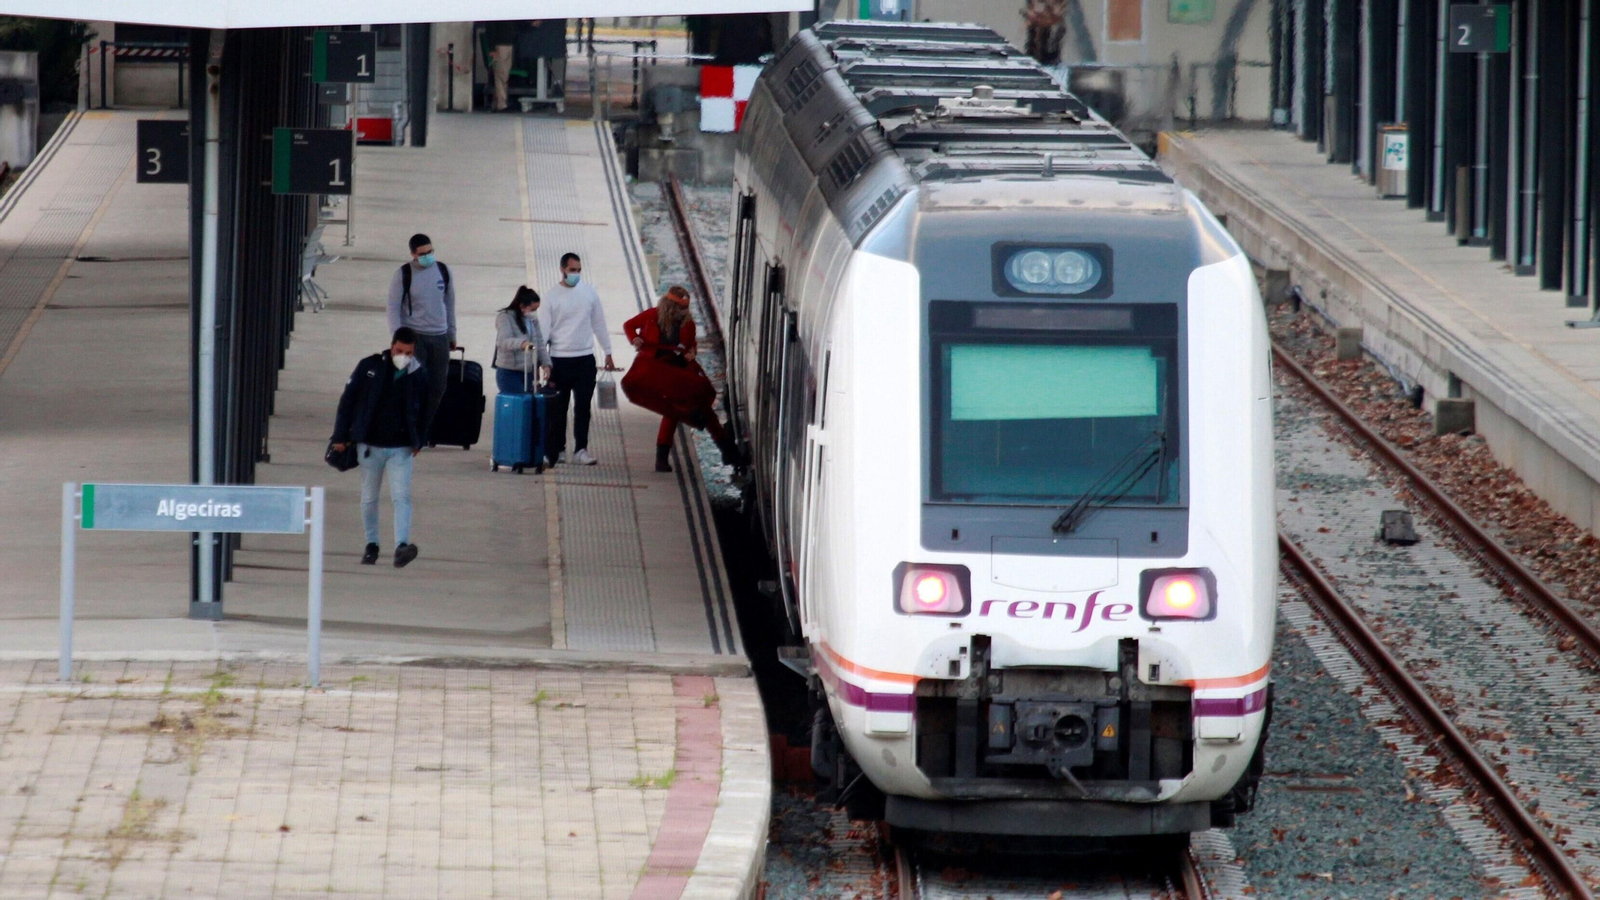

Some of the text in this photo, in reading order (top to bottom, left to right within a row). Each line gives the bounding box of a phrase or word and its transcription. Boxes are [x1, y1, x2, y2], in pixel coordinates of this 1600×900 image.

[1457, 24, 1471, 46] 2
[357, 54, 370, 77] 1
[146, 147, 162, 175] 3
[329, 158, 345, 186] 1
[156, 499, 242, 520] Algeciras
[979, 590, 1133, 634] renfe
